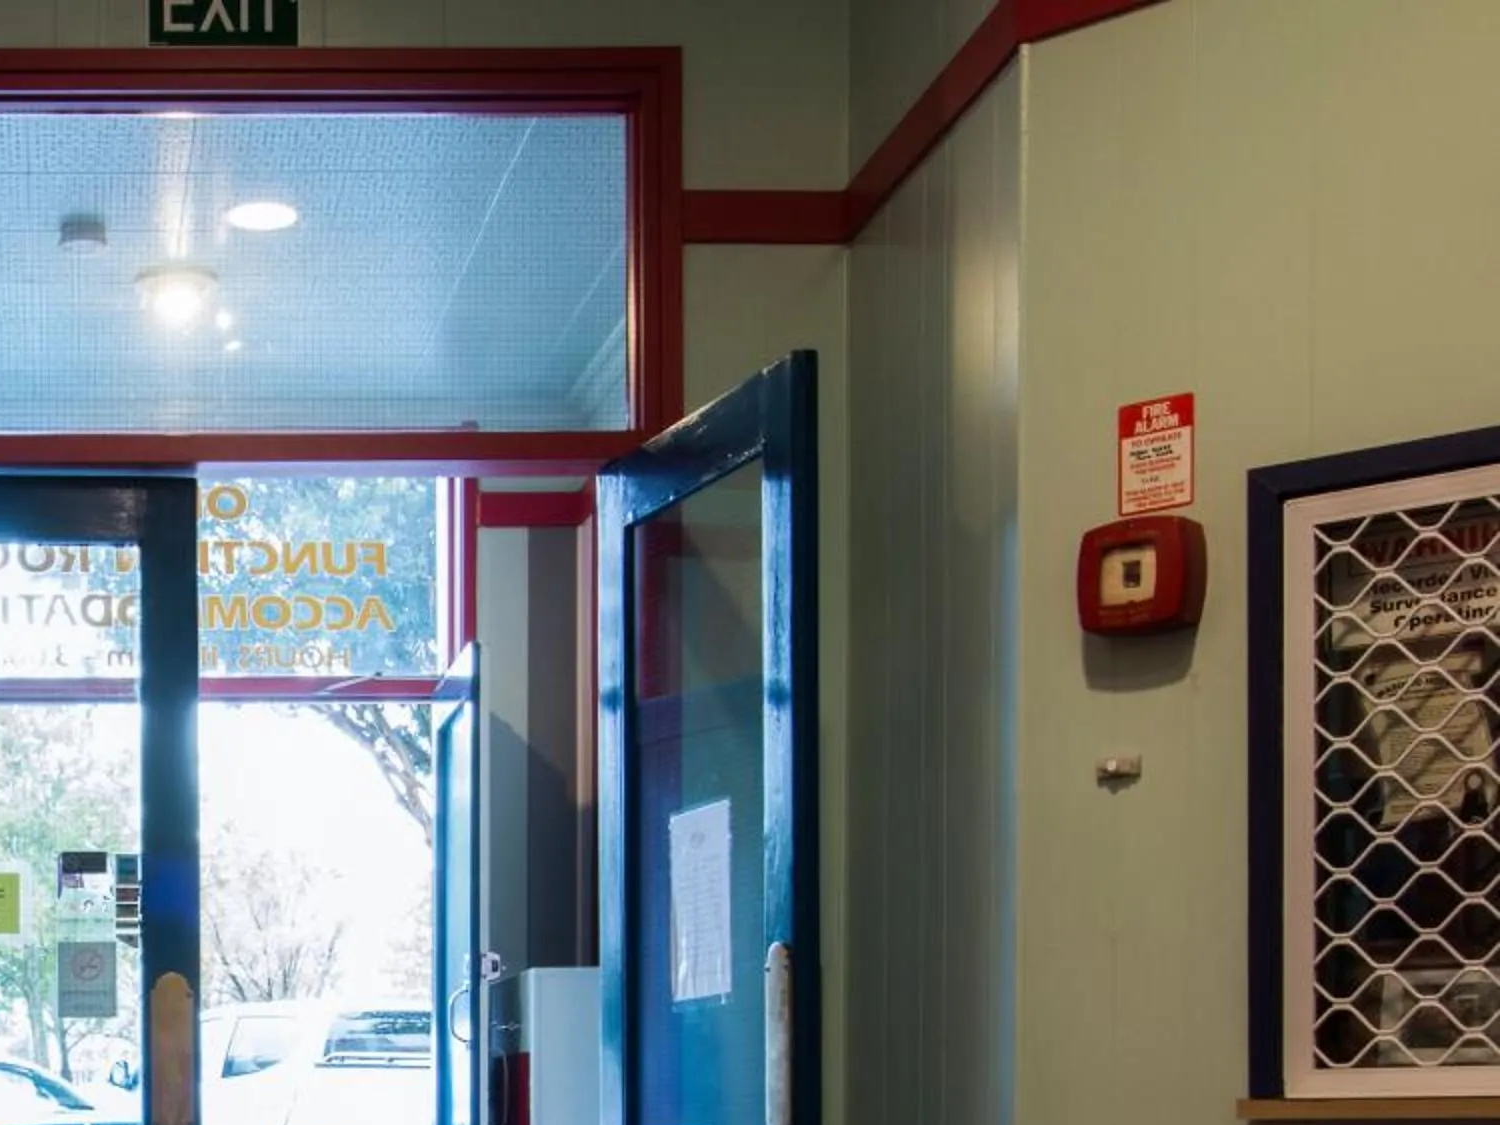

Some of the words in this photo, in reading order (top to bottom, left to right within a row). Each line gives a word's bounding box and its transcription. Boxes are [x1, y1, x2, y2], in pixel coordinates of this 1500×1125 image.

[1142, 401, 1172, 418] FIRE
[1134, 412, 1180, 434] ALARM
[1369, 585, 1497, 614] Survlance
